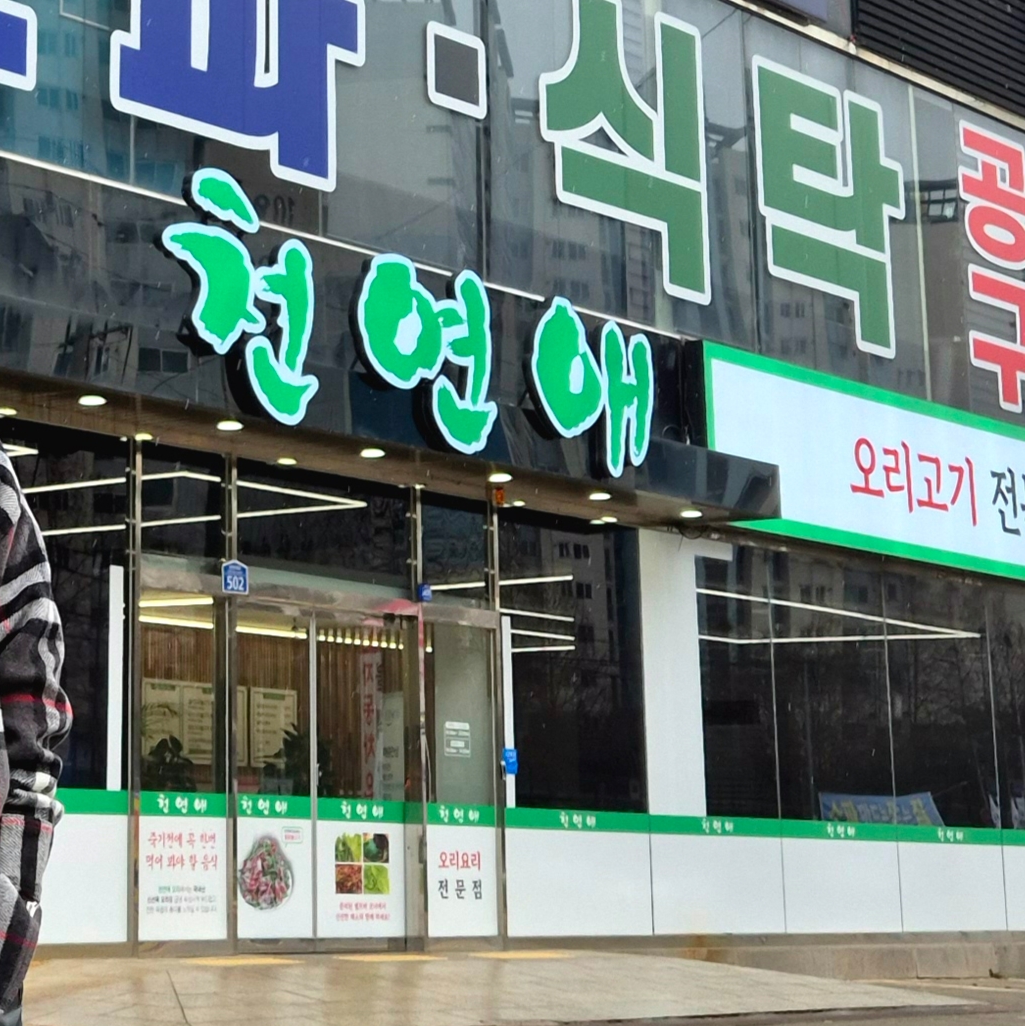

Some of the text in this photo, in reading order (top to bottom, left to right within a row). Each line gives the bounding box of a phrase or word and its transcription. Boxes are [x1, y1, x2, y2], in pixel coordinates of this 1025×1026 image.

[850, 437, 1025, 536] 오리고기 전
[227, 575, 244, 591] 502
[201, 854, 218, 871] 음식
[438, 850, 481, 871] 오리요리
[438, 879, 482, 900] 전문점
